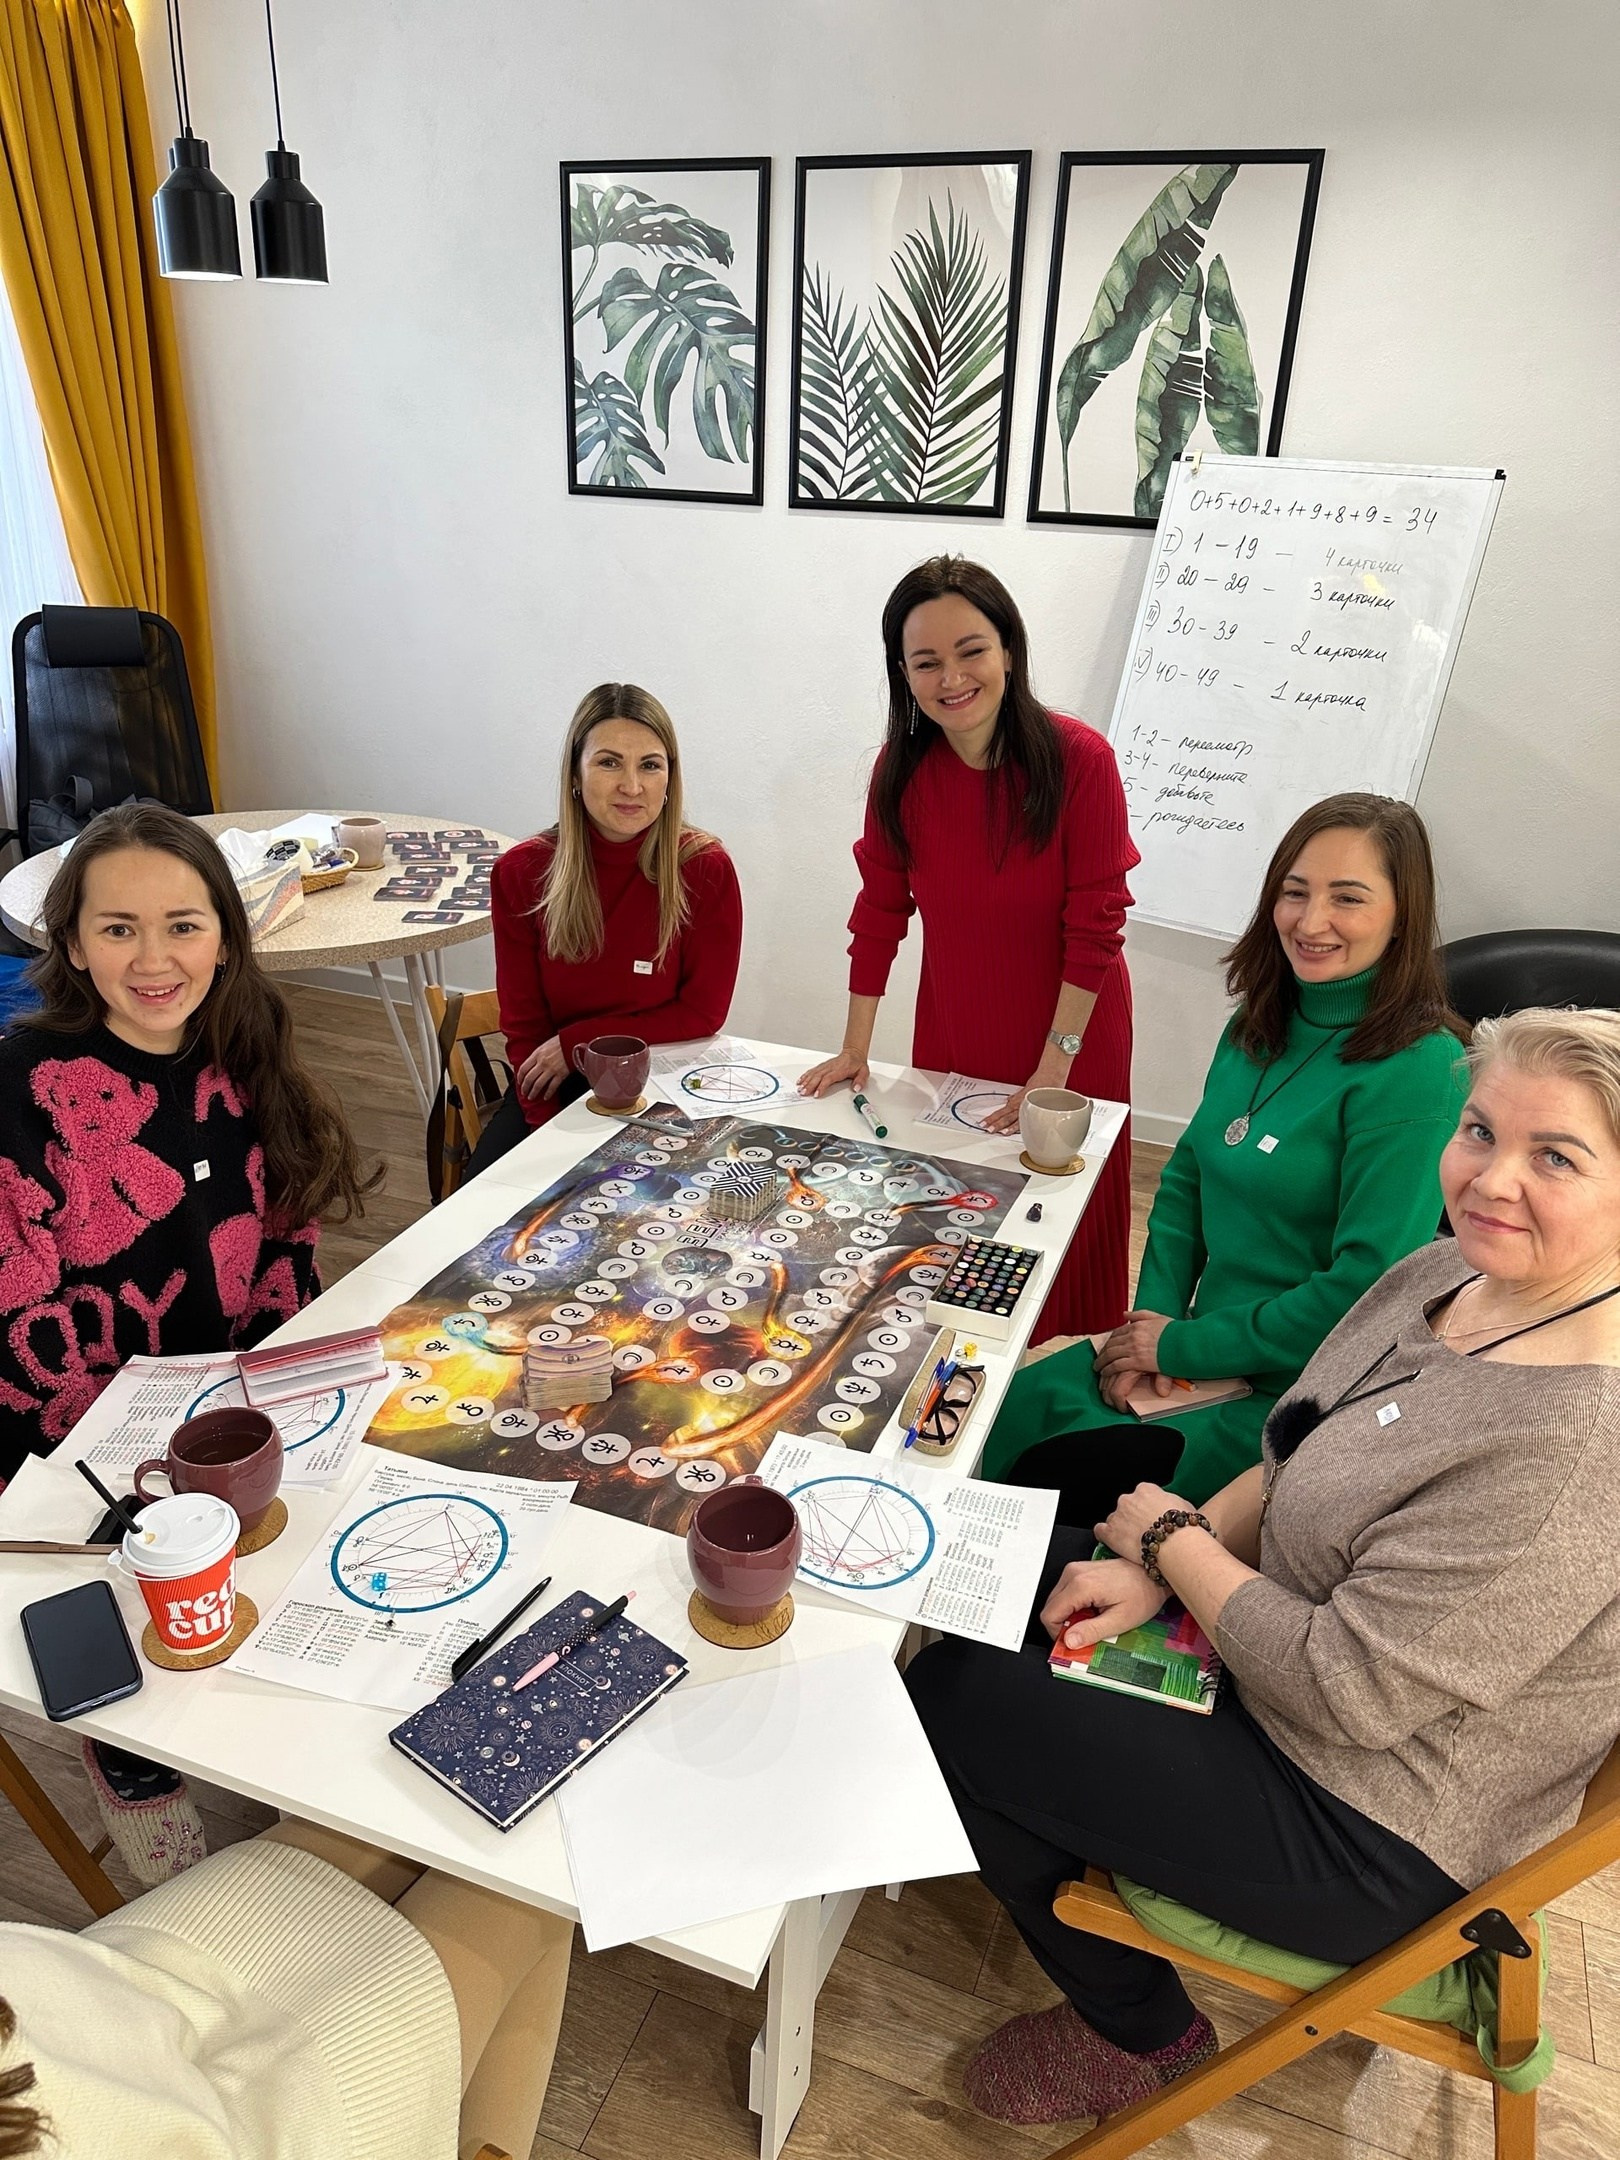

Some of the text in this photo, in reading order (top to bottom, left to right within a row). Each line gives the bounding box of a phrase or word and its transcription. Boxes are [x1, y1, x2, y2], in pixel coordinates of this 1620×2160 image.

[1405, 507, 1438, 534] 34
[1337, 555, 1405, 576] карточки
[1310, 581, 1323, 601] 3
[1328, 591, 1397, 611] карточки
[1290, 630, 1311, 655] 2
[1313, 642, 1388, 663] карточки
[1270, 680, 1289, 702] 1
[1294, 690, 1367, 711] карточка
